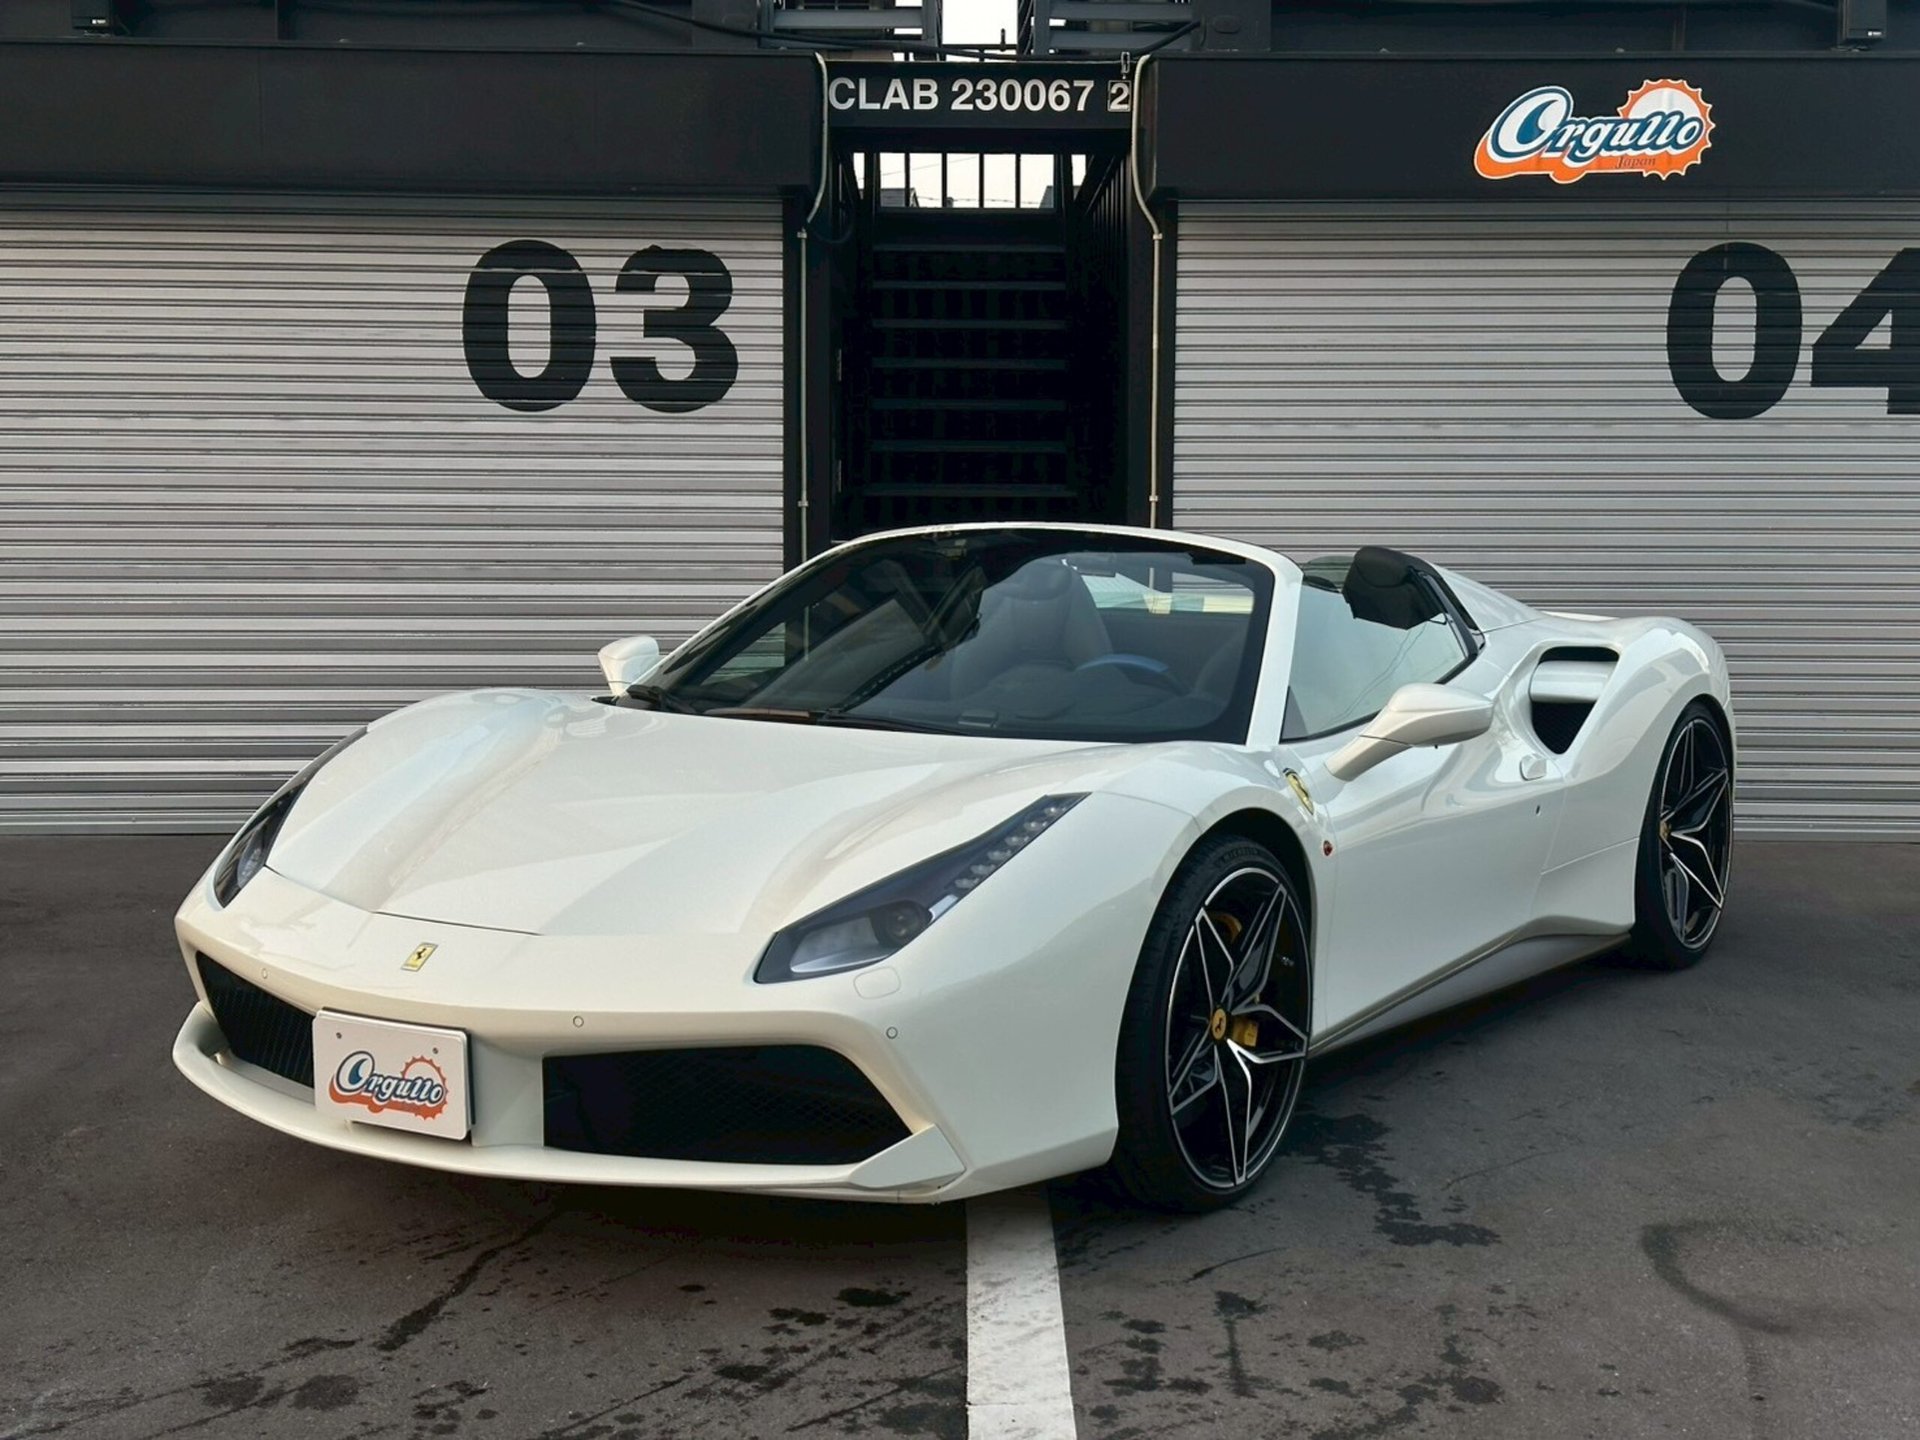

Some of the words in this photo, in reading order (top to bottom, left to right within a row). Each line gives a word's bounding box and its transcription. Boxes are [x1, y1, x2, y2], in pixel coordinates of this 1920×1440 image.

[828, 77, 939, 110] CLAB
[951, 79, 1094, 111] 230067
[1109, 81, 1130, 110] 2
[1491, 87, 1705, 162] Orgullo
[1615, 155, 1656, 169] Japan
[462, 239, 738, 413] 03
[1666, 241, 1920, 420] 04
[336, 1050, 444, 1105] Orgullo
